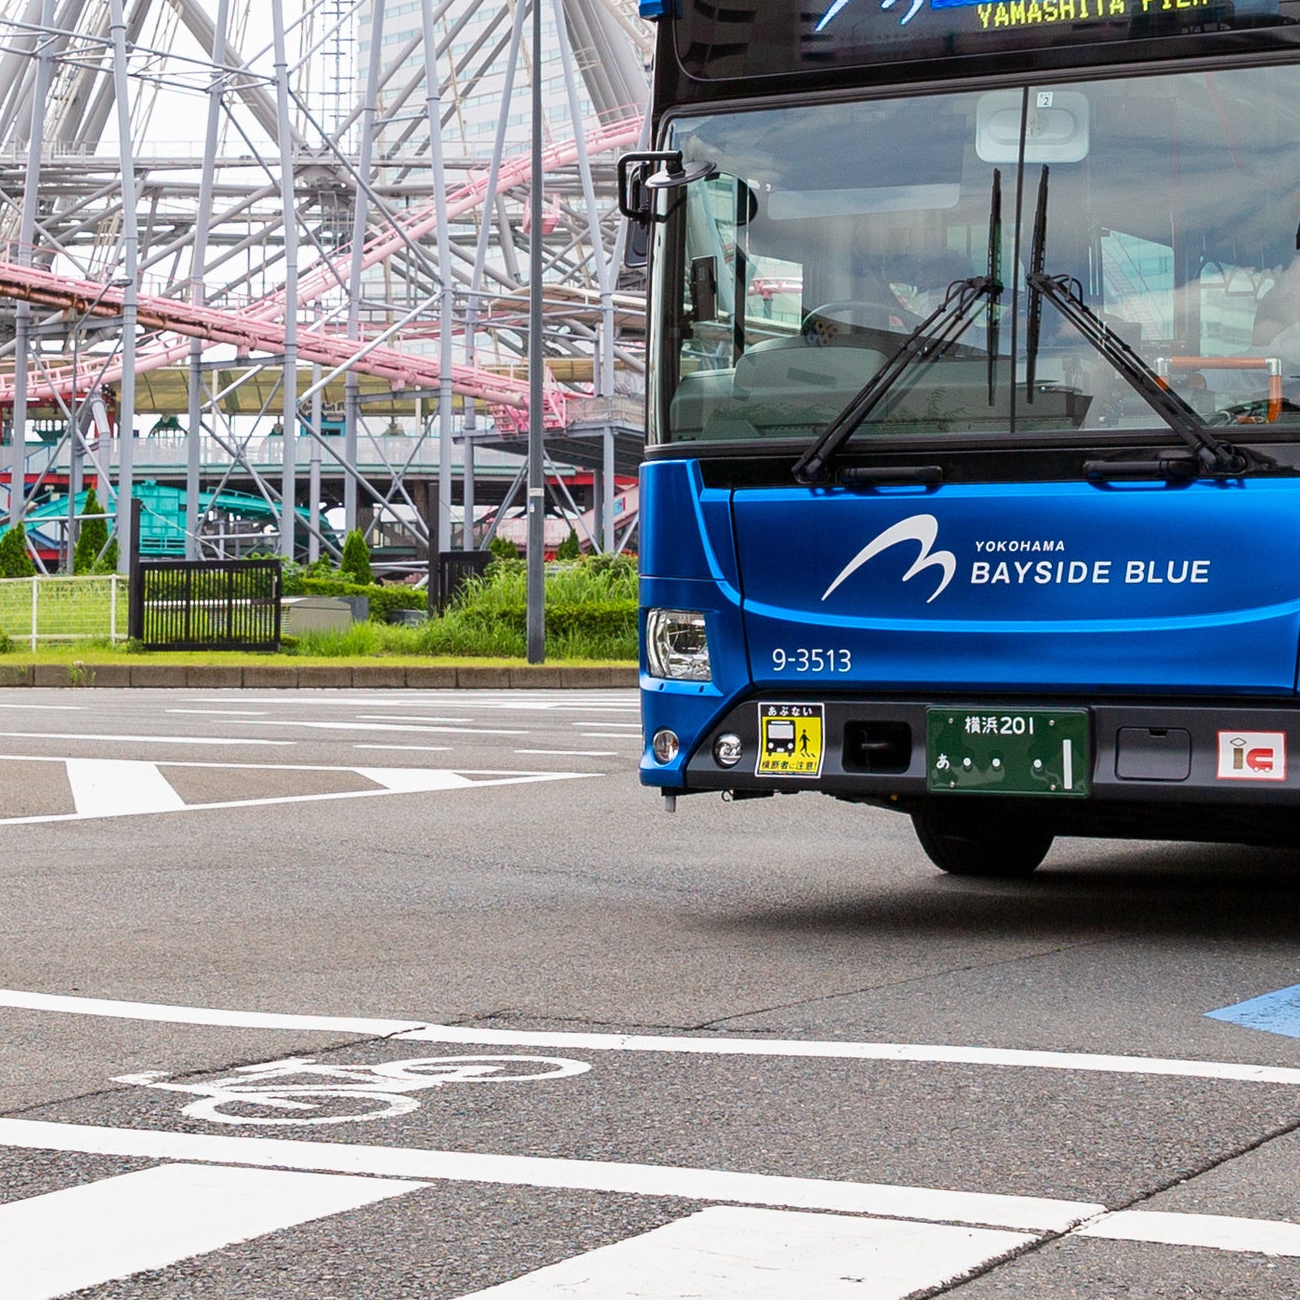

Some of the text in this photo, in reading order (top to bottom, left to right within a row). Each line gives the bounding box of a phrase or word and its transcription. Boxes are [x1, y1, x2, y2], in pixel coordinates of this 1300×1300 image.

[975, 540, 1065, 552] YOKOHAMA
[971, 560, 1211, 584] BAYSIDE BLUE
[772, 648, 852, 672] 9-3513
[768, 706, 812, 716] あぶない
